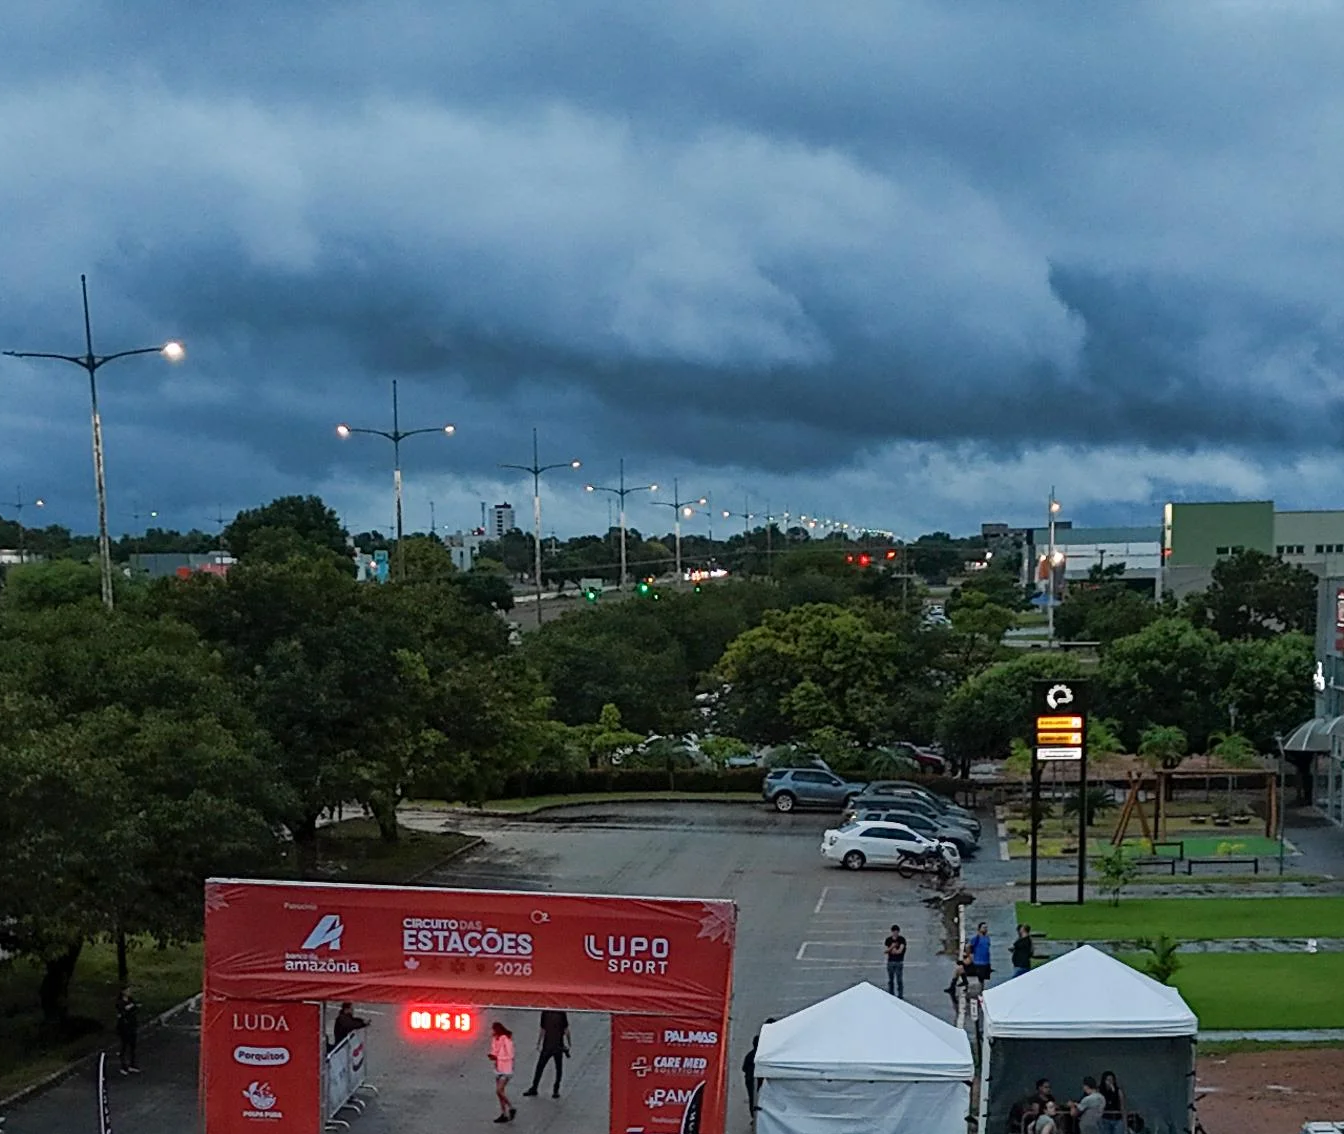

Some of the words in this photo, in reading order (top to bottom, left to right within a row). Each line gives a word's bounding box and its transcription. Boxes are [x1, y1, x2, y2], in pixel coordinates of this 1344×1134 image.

[403, 918, 458, 930] CIRCUITO
[459, 921, 482, 931] DAS
[403, 928, 533, 957] ESTAÇÕES
[584, 935, 669, 961] LUPO
[285, 957, 360, 973] amazônia
[494, 962, 532, 976] 2026
[608, 960, 668, 974] SPORT
[233, 1013, 290, 1032] LUDA
[664, 1030, 718, 1044] PALMAS
[238, 1050, 285, 1064] Porquitos
[654, 1056, 681, 1068] CARE
[683, 1057, 707, 1069] MED
